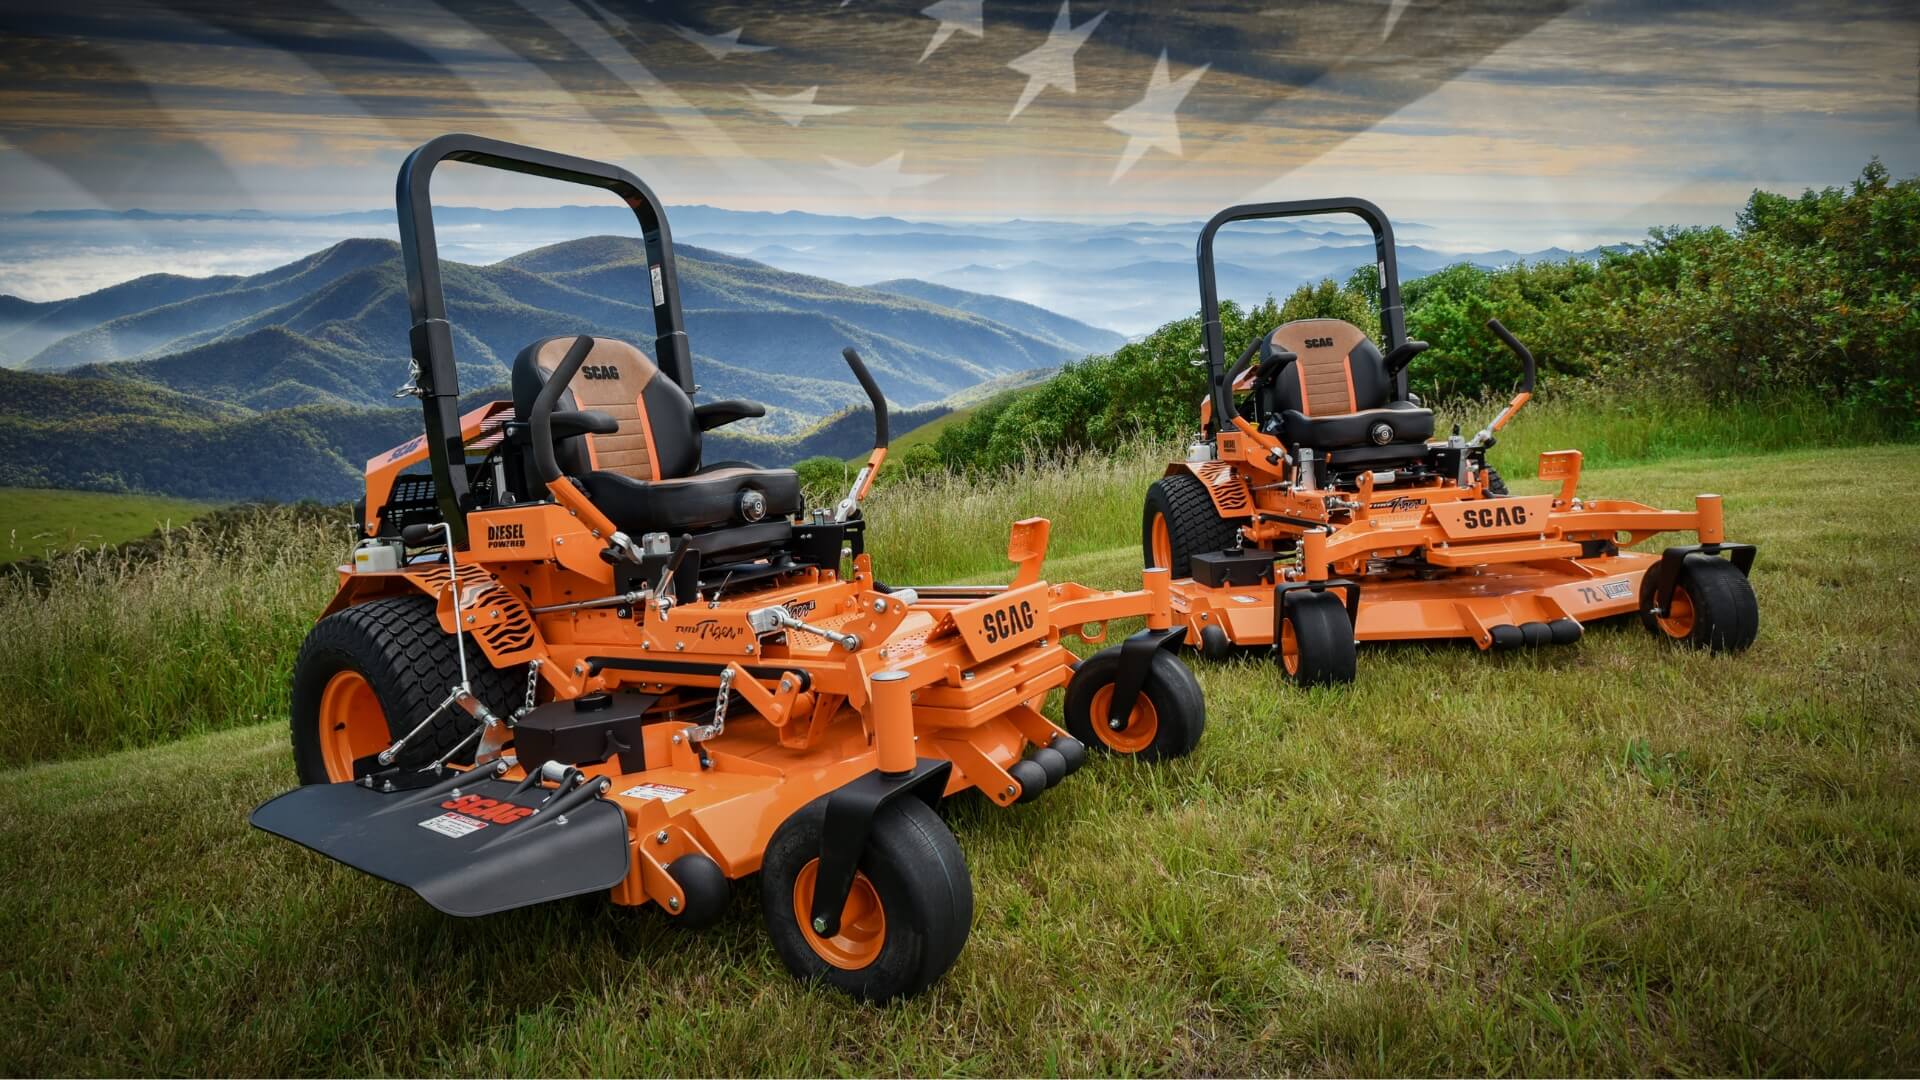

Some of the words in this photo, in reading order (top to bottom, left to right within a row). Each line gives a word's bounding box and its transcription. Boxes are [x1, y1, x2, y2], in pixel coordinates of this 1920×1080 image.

[1304, 338, 1333, 348] SCAG
[581, 365, 620, 380] SCAG
[1463, 505, 1527, 529] SCAG
[487, 524, 525, 541] DIESEL
[487, 540, 526, 549] POWERED
[1577, 587, 1603, 604] 72
[696, 619, 736, 641] Tiger
[982, 600, 1034, 644] SCAG
[440, 794, 535, 826] SCAG
